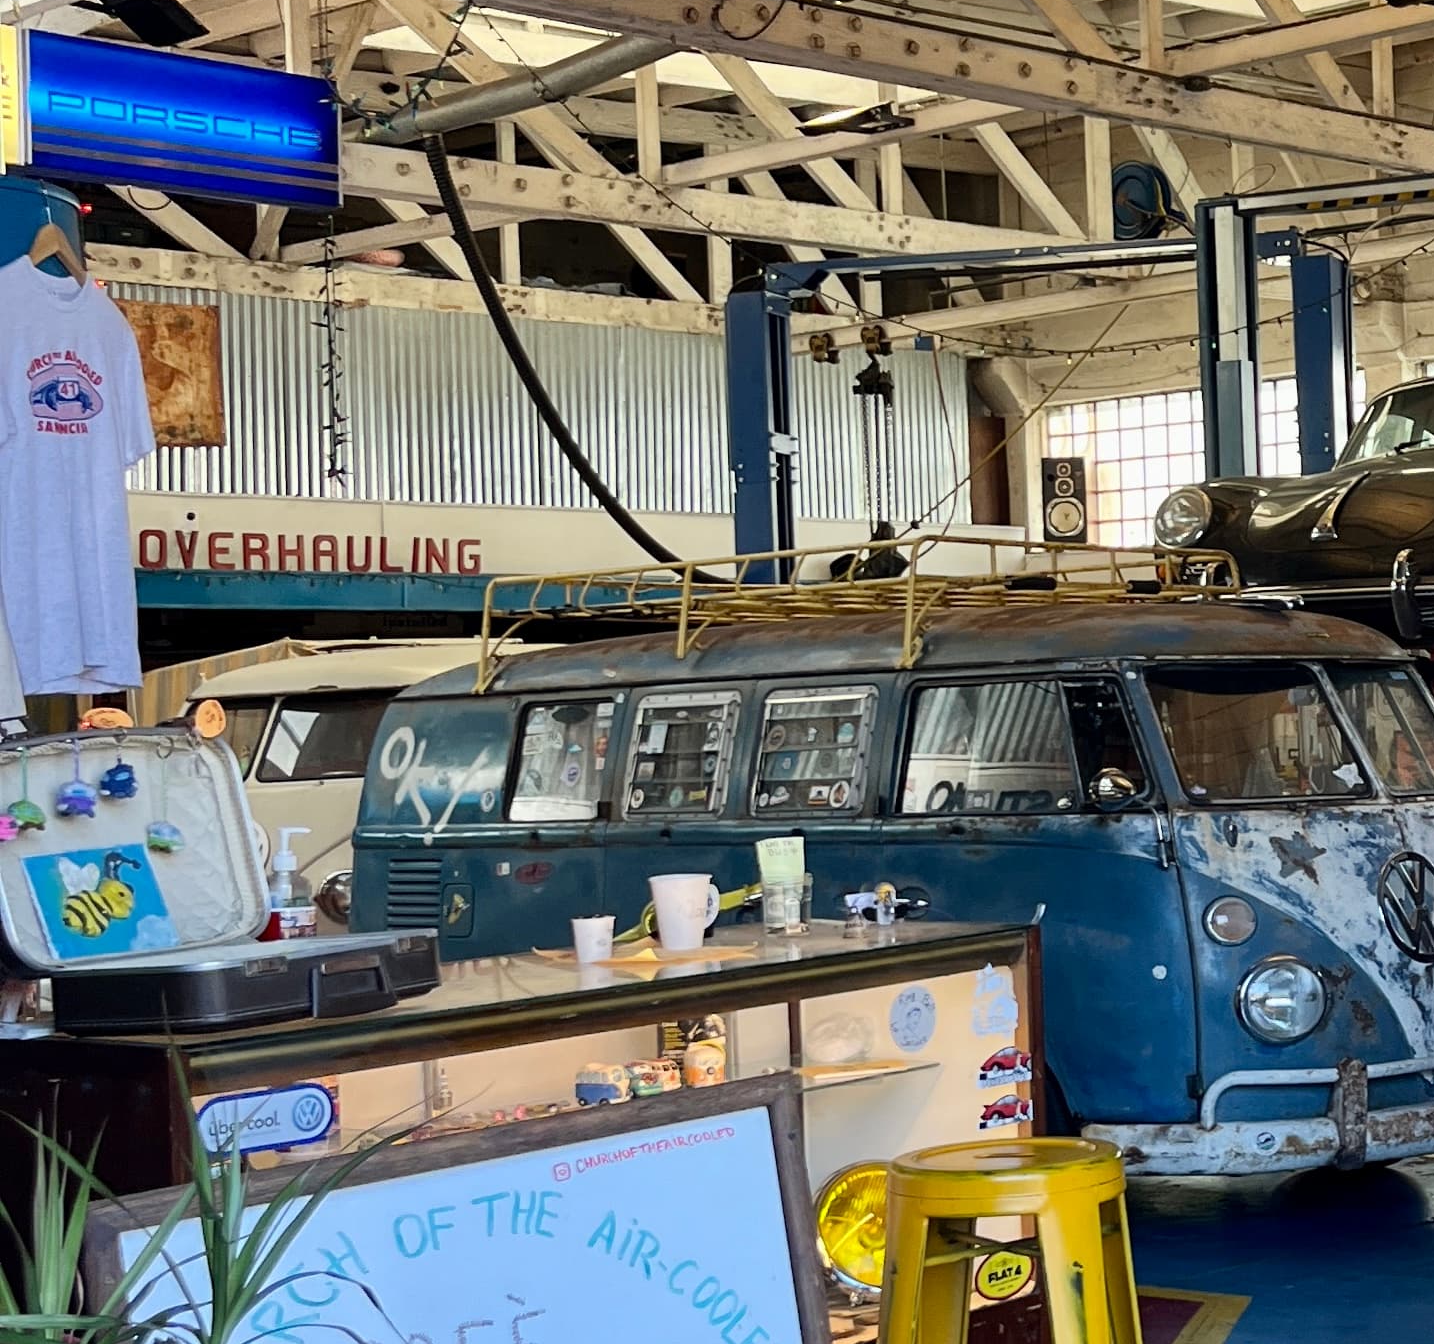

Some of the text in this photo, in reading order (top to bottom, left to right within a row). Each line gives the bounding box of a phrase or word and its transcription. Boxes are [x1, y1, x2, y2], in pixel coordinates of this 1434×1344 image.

[48, 90, 322, 151] PORSCHE
[138, 528, 482, 575] OVERHAULING
[575, 1126, 736, 1174] CHURCHOFTHEAIRCOOLED
[392, 1205, 457, 1259] OF
[471, 1189, 563, 1239] THE
[987, 1267, 1013, 1284] FLAT
